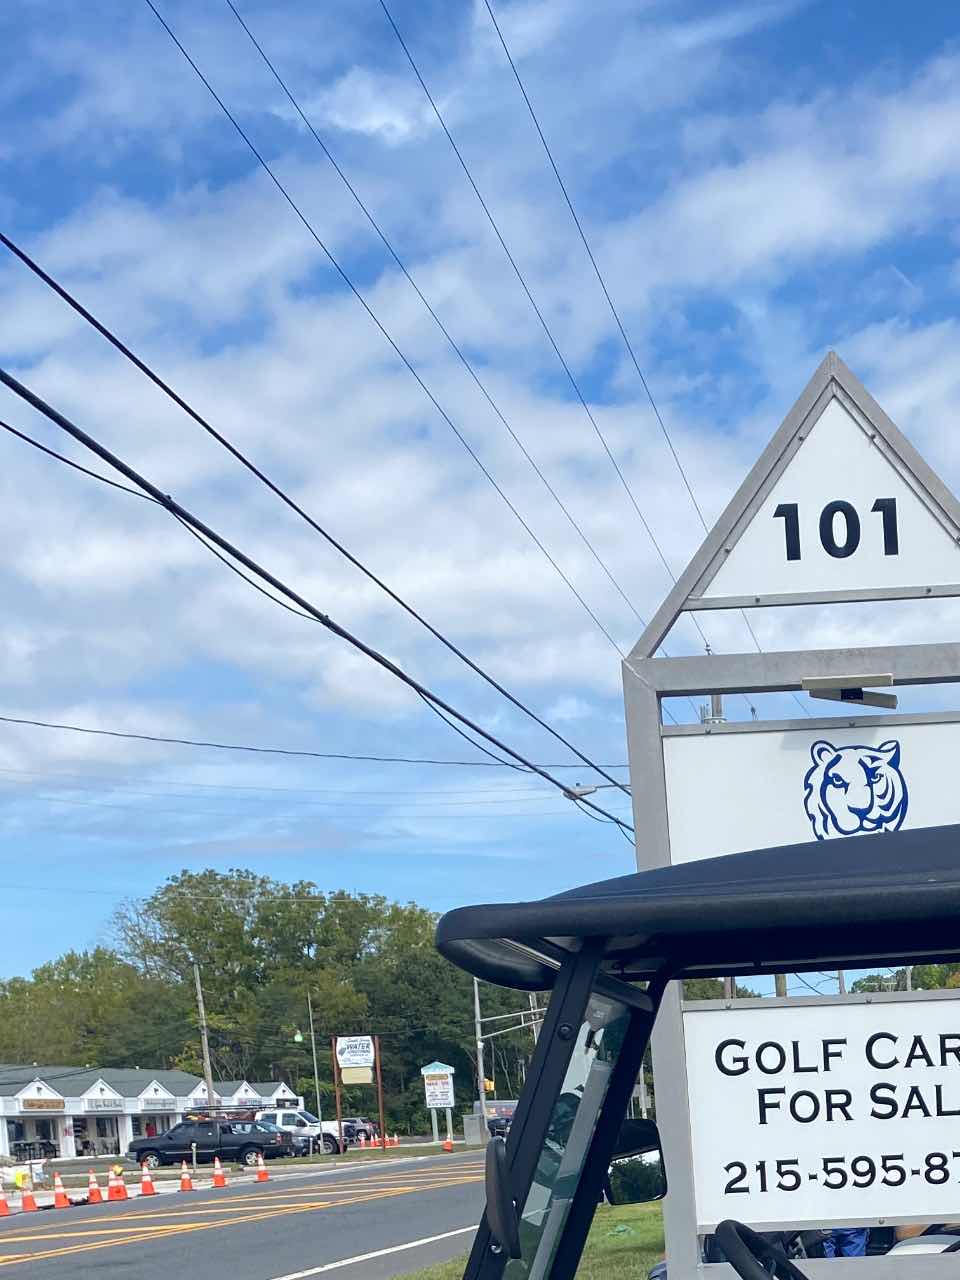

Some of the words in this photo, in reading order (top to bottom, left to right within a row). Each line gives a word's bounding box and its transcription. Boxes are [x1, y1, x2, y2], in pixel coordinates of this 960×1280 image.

[773, 498, 899, 561] 101
[714, 1038, 848, 1077] GOLF
[756, 1086, 854, 1125] FOR
